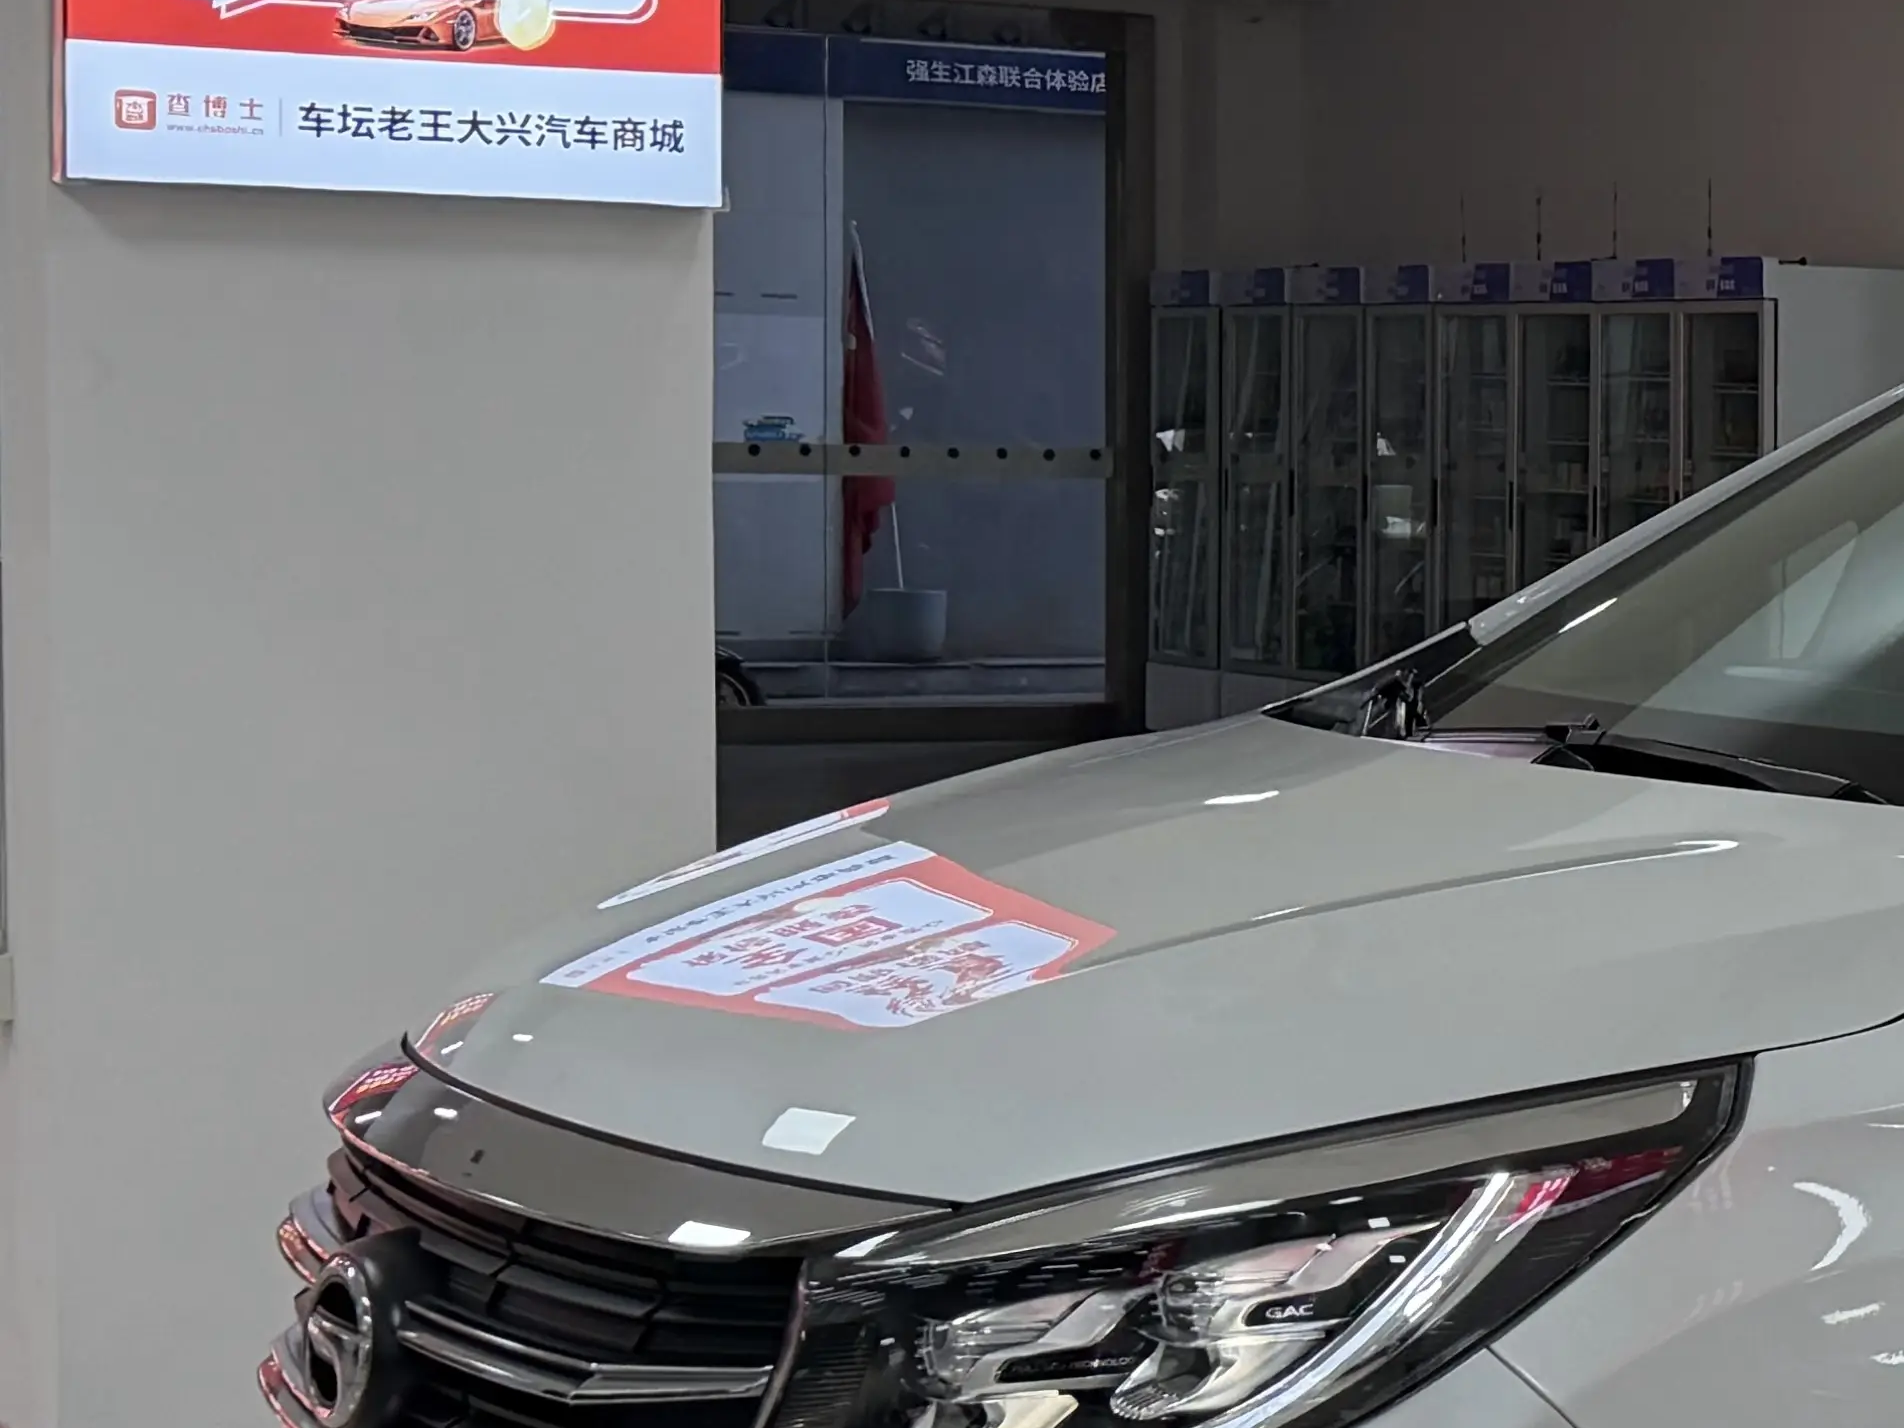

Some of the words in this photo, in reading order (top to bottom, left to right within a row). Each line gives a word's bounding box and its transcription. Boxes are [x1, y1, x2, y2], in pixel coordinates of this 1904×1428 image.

[297, 102, 685, 154] 车坛老王大兴汽车商城
[1265, 1304, 1314, 1319] GAC
